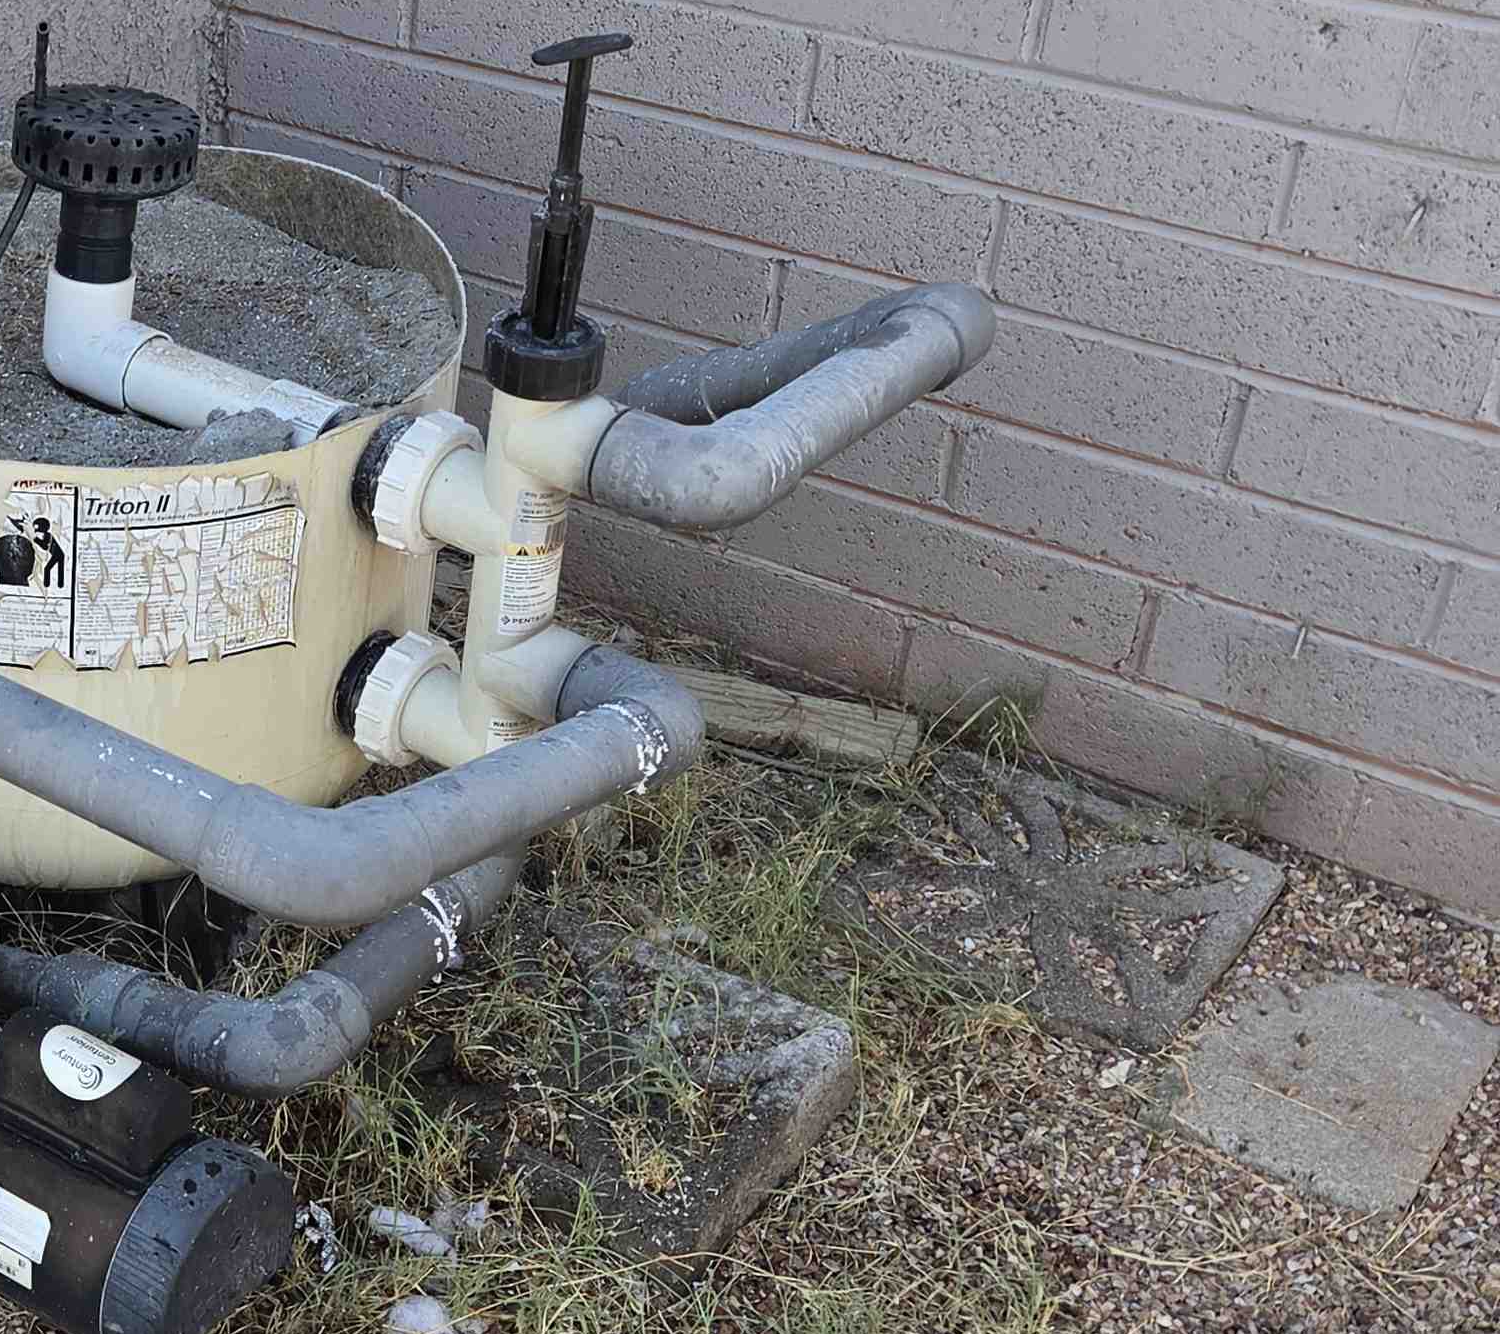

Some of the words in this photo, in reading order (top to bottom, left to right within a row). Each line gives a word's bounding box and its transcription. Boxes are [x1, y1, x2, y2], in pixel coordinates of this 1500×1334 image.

[85, 497, 150, 515] Triton
[156, 495, 171, 513] II
[55, 1049, 94, 1079] Century
[68, 1035, 117, 1066] Centurion
